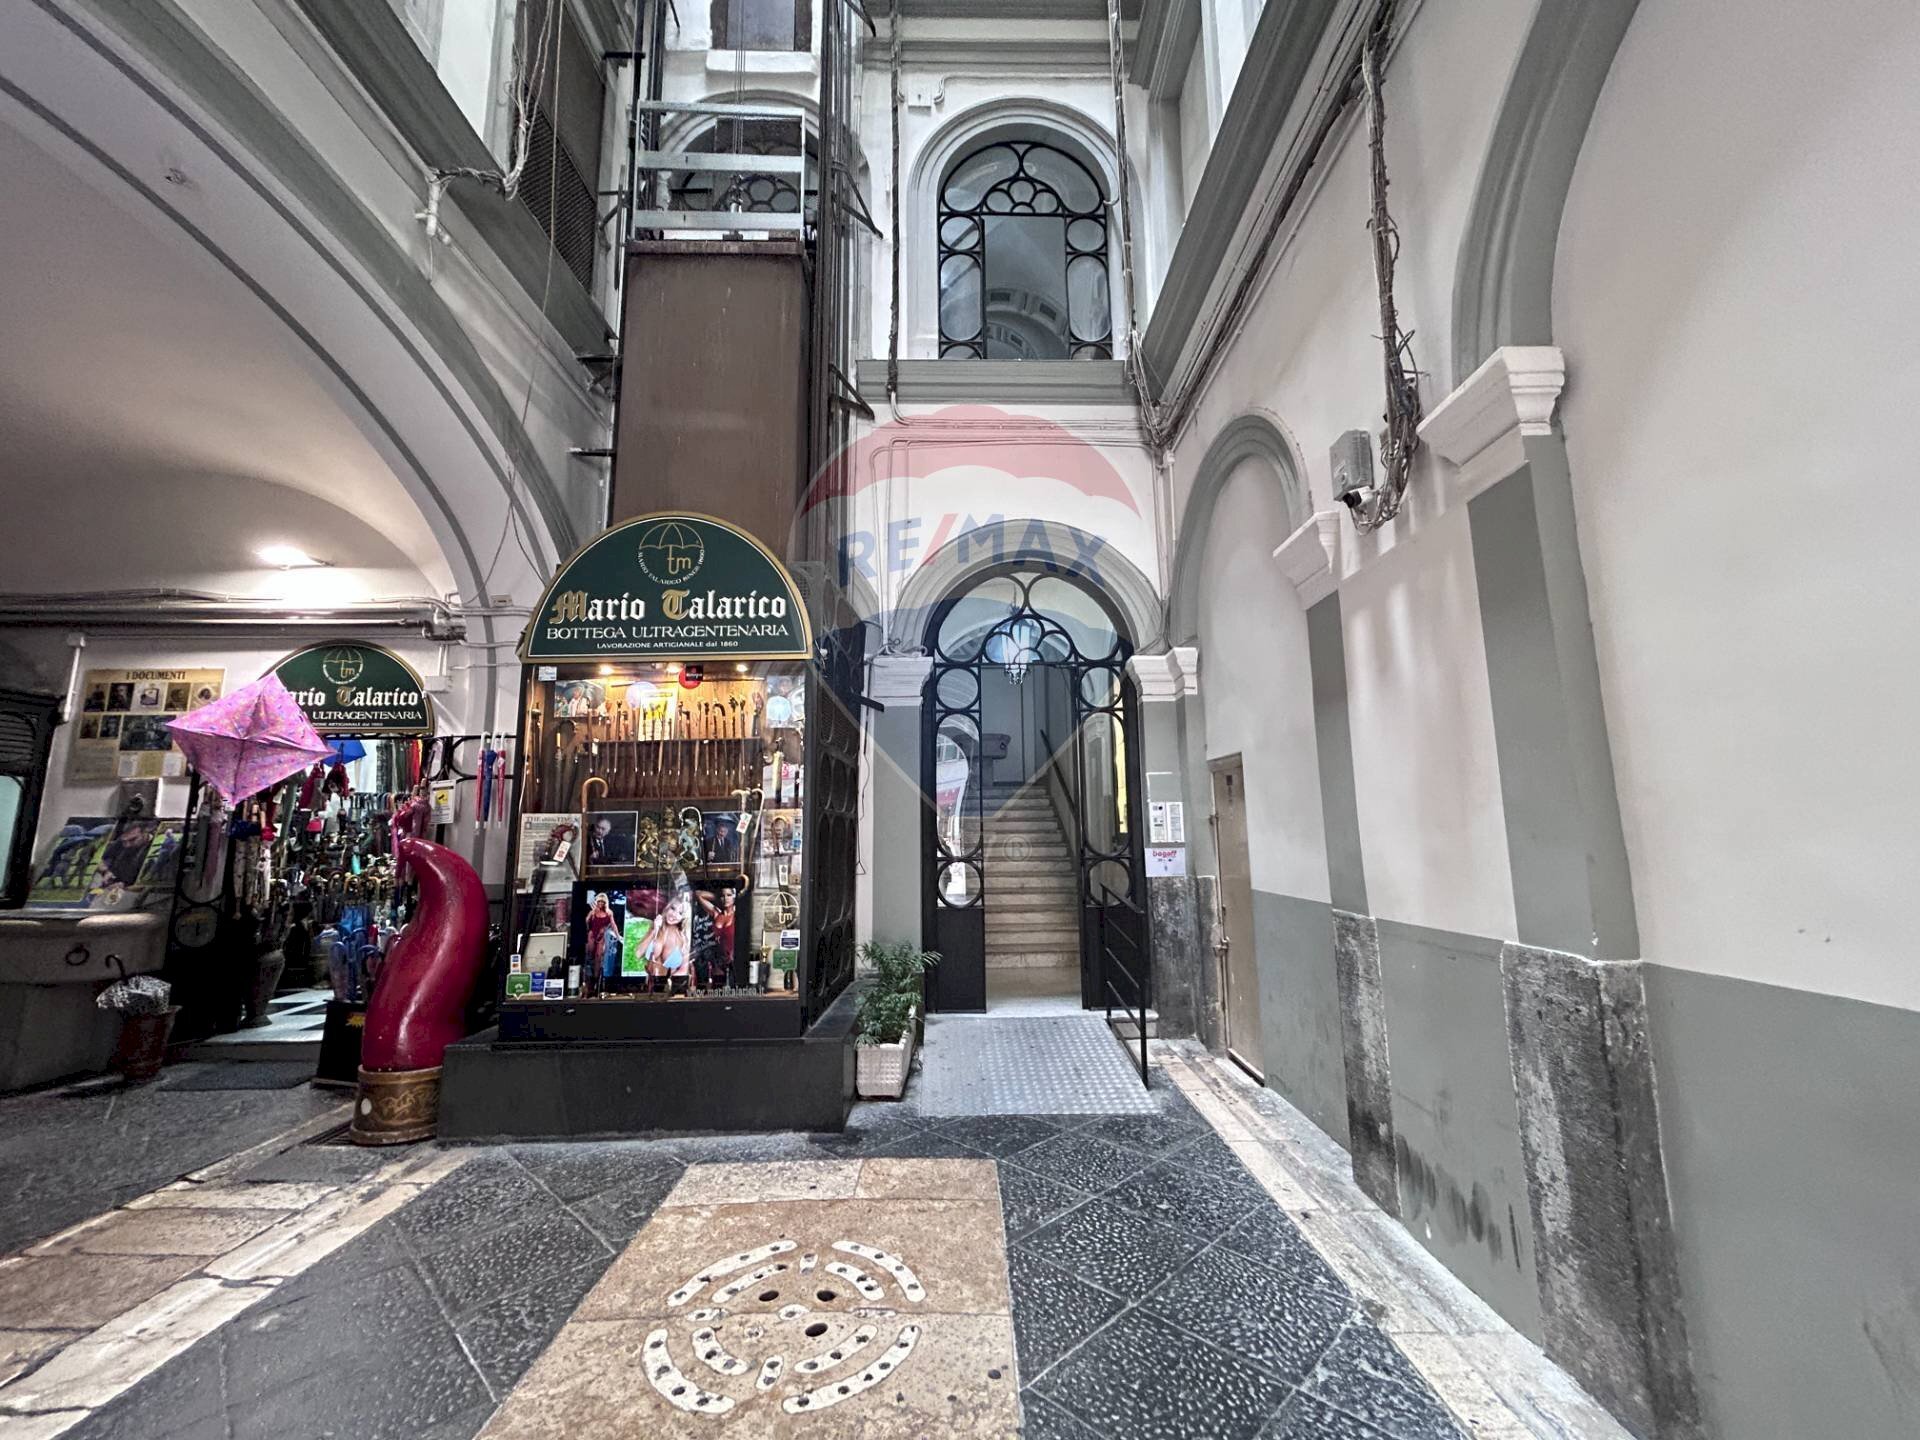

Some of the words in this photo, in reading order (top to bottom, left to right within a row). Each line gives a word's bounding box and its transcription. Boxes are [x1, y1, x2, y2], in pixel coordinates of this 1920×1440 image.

[549, 590, 645, 624] Mario
[662, 589, 786, 620] Talarico
[547, 626, 626, 639] BOTTEGA
[632, 624, 789, 639] ULTRACENTENARIA
[131, 671, 186, 680] DOCUMENTI
[337, 686, 418, 707] Talarico
